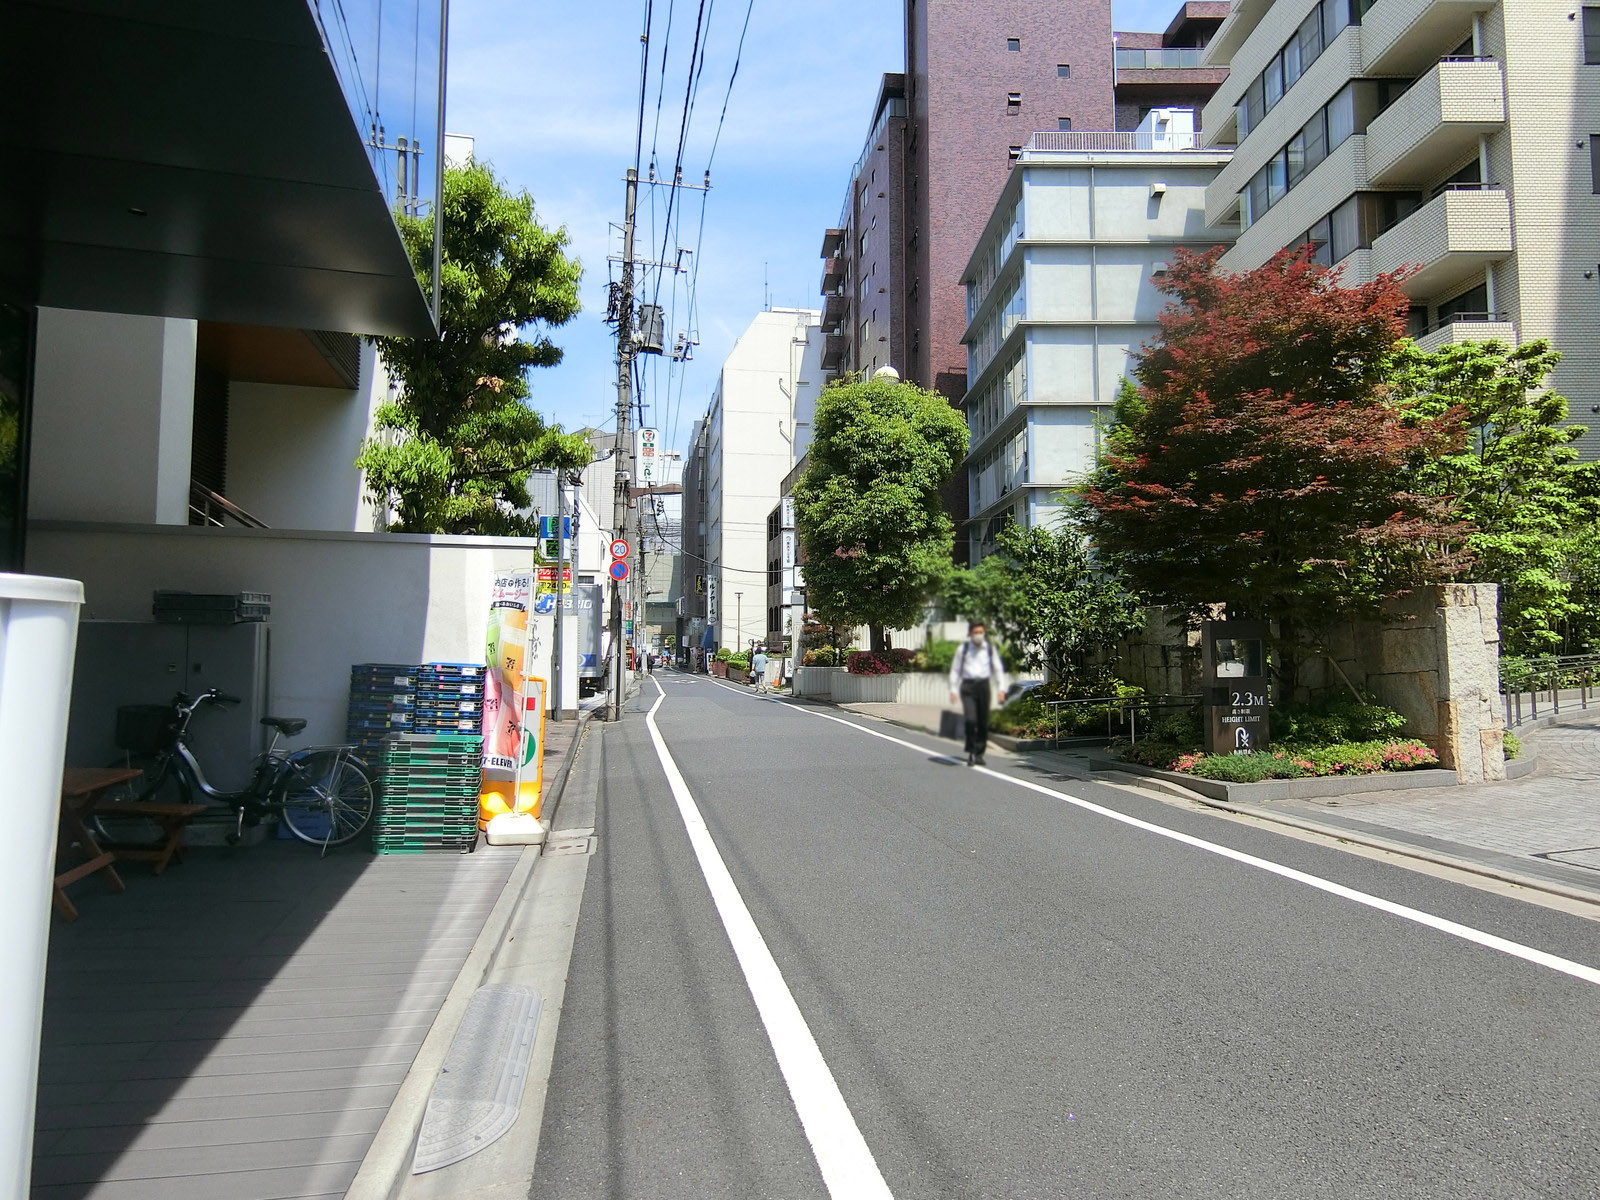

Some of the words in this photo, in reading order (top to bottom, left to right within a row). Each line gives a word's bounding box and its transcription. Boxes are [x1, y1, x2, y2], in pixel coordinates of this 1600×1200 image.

[614, 544, 626, 554] 20
[538, 568, 571, 576] クレジットード
[546, 599, 592, 609] HBID
[709, 583, 717, 615] ルノアール
